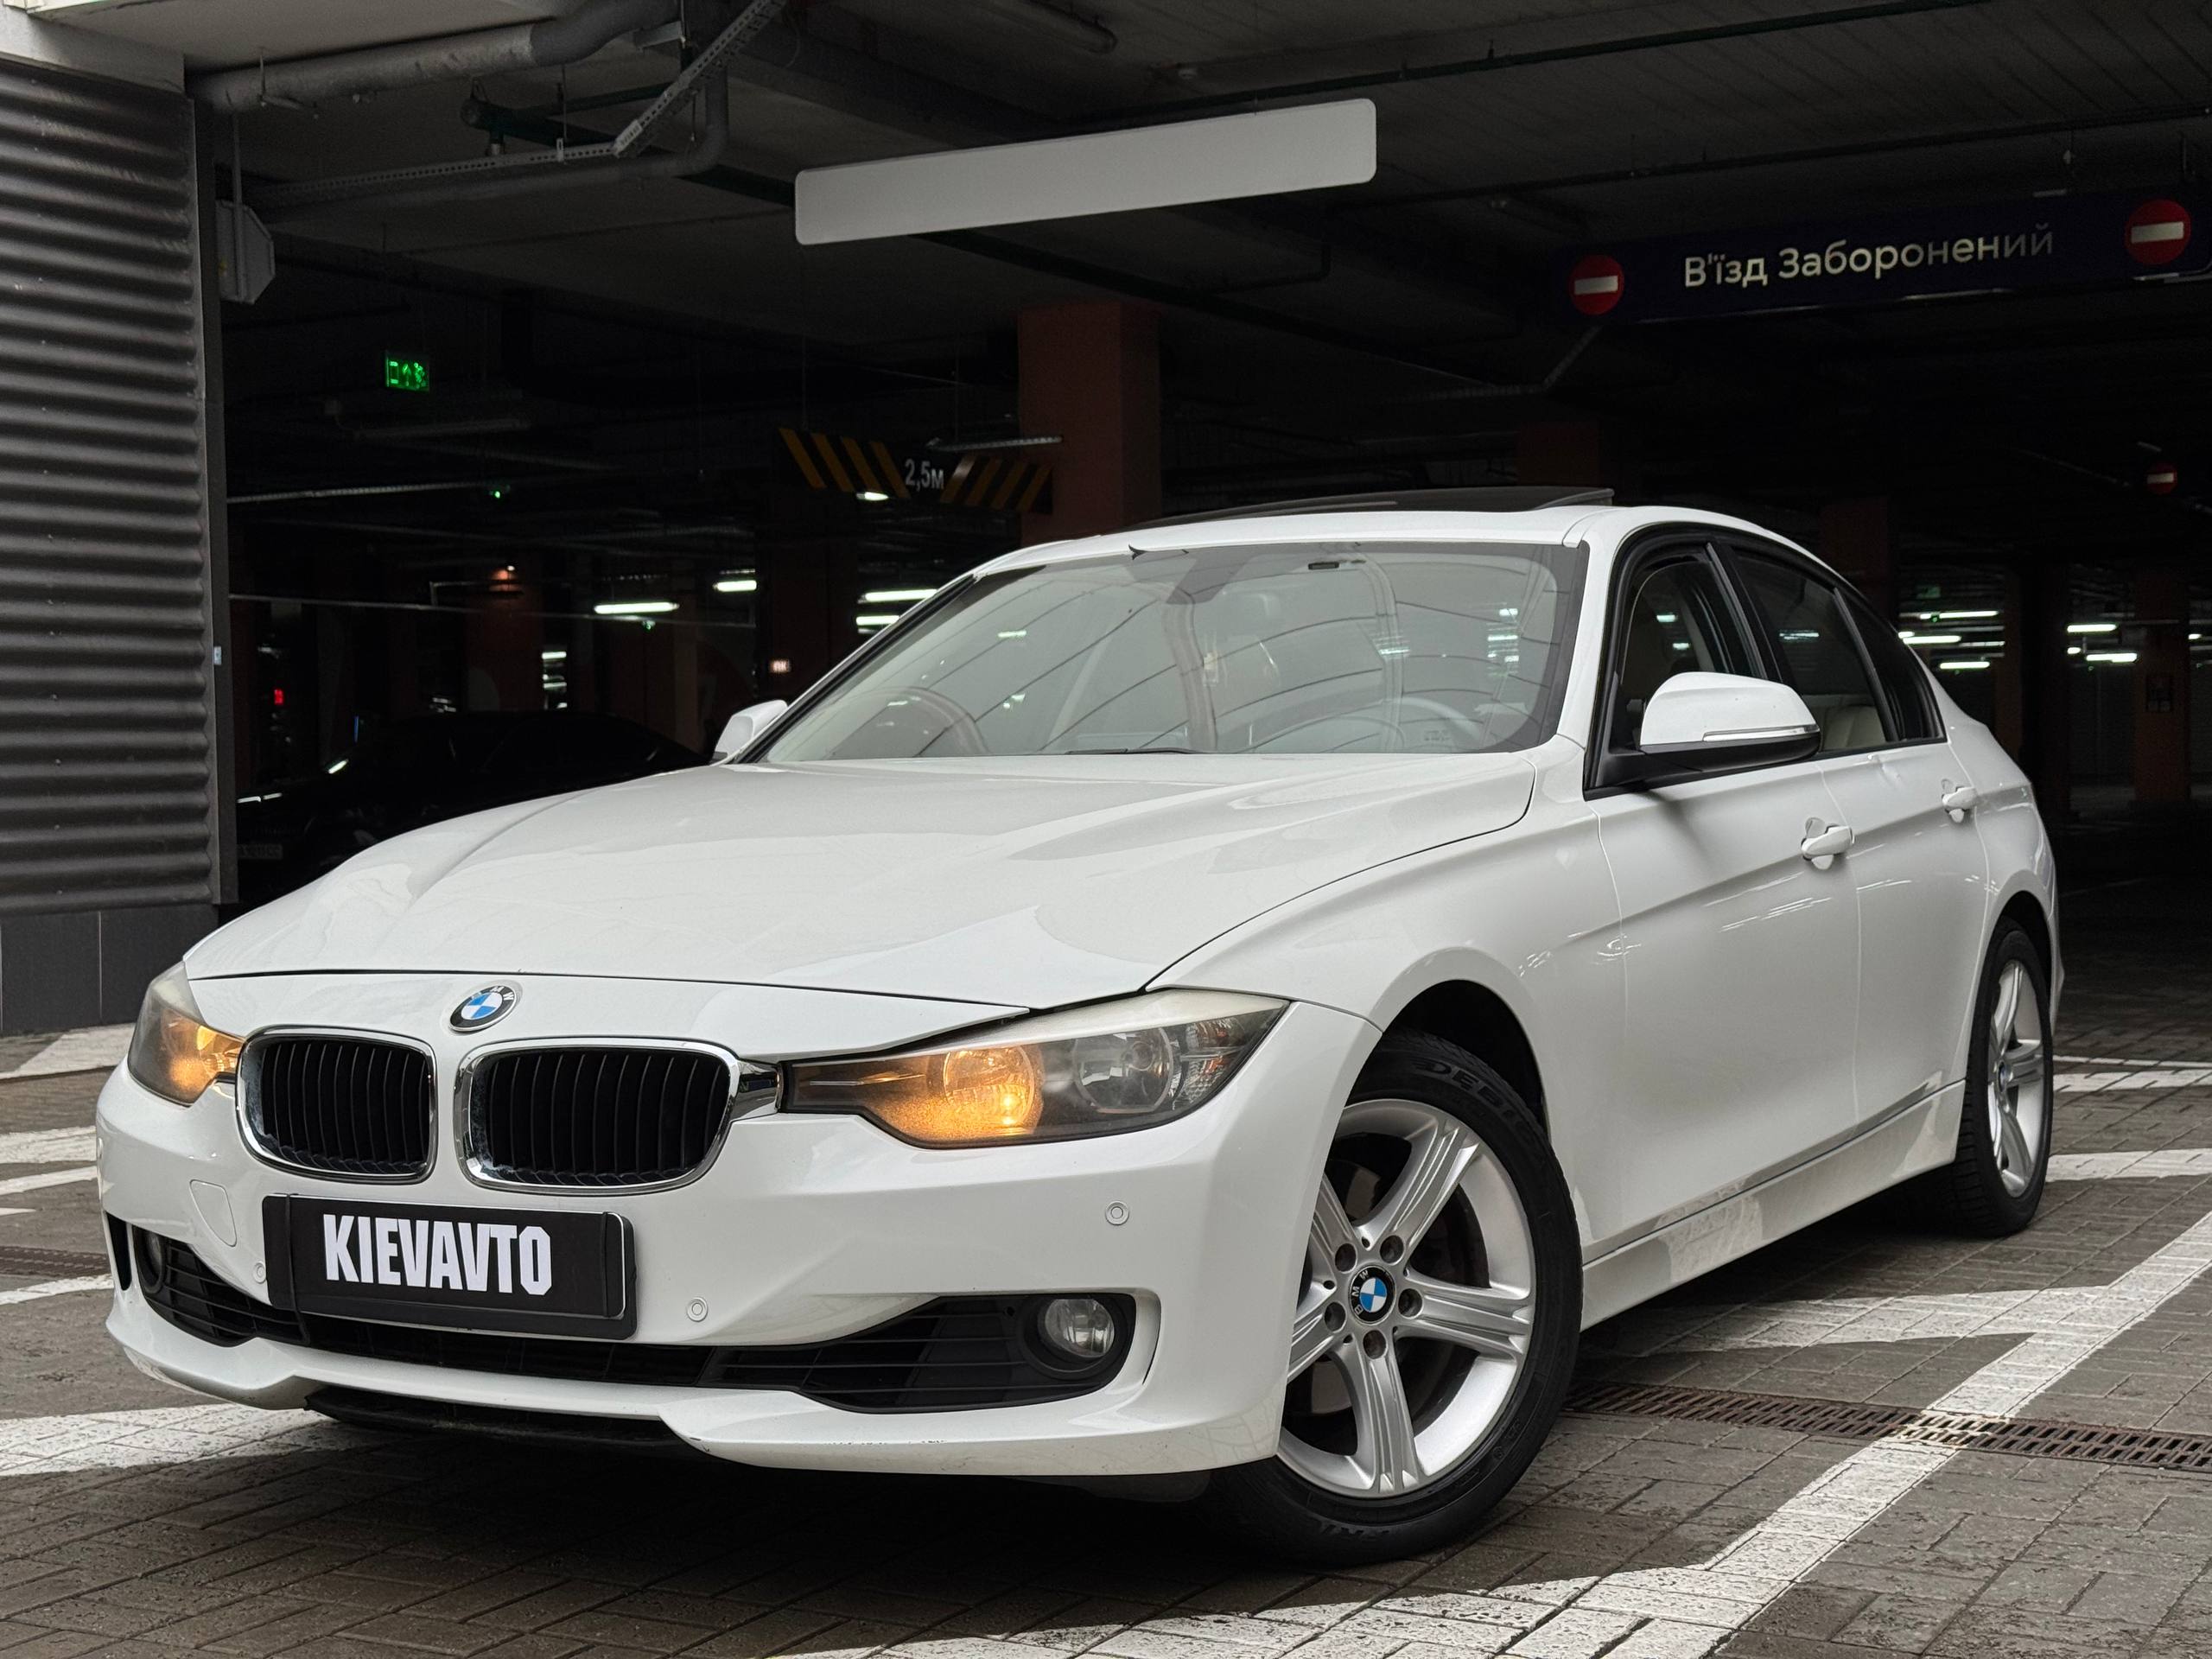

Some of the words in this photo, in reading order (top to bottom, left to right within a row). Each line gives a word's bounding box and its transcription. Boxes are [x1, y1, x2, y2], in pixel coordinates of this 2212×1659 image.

[1685, 253, 1769, 288] В'їзд
[1778, 222, 2053, 280] Заборонений
[322, 1213, 553, 1296] KIEVAVTO
[1351, 1269, 1369, 1315] BMW
